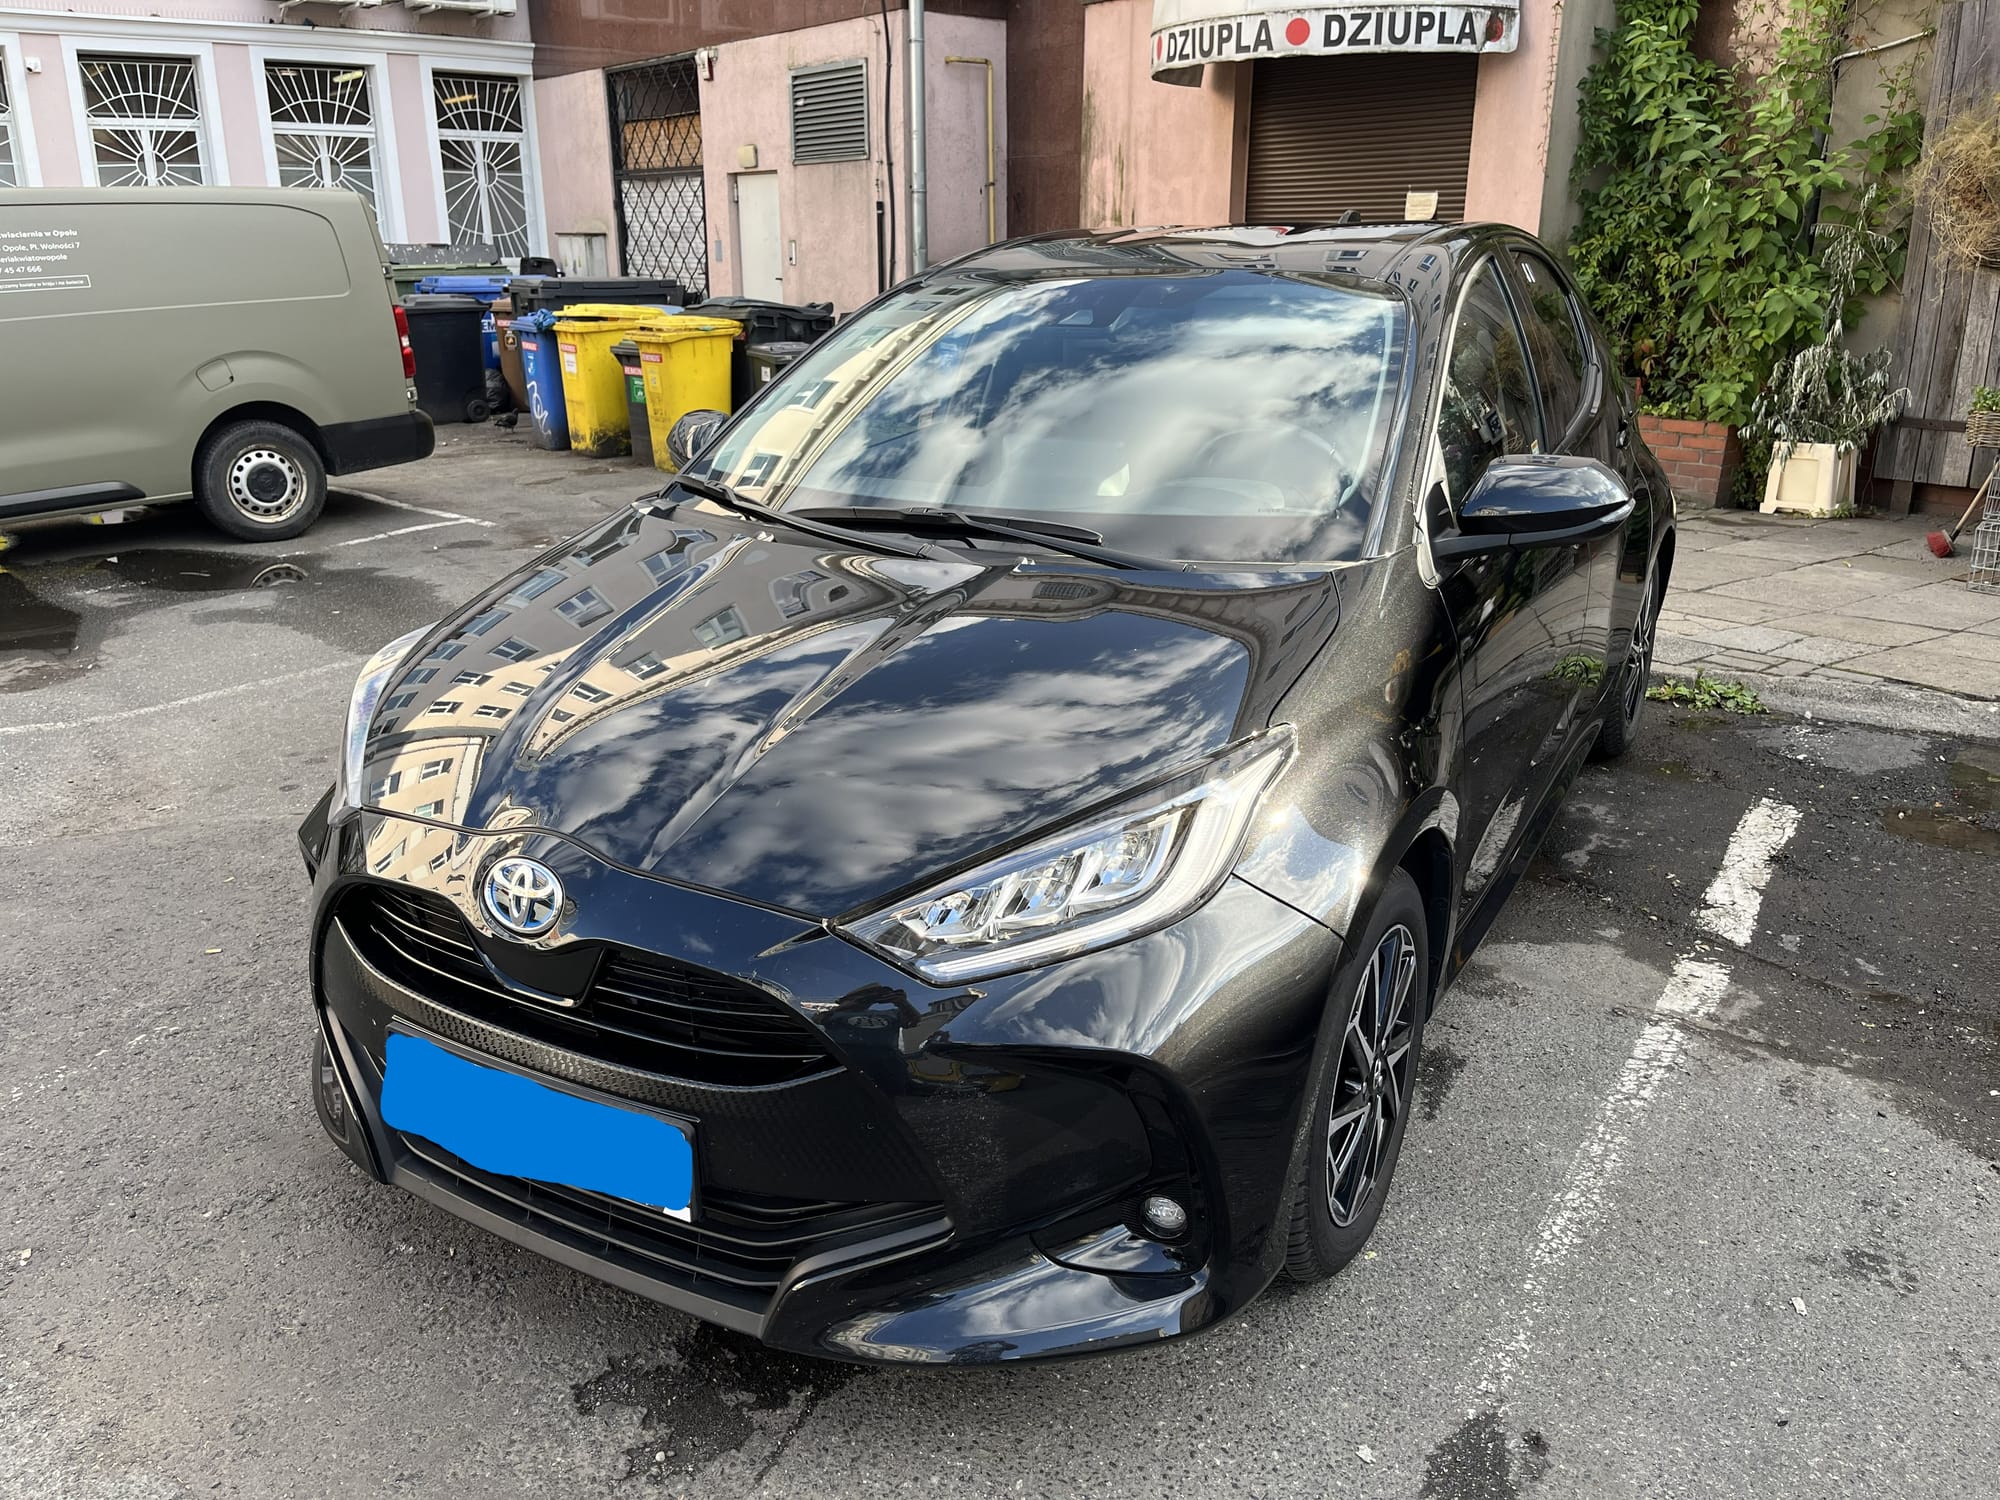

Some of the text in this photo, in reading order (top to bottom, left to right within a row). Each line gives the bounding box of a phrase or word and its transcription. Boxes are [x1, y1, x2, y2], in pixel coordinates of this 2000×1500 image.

[1166, 18, 1274, 63] DZIUPLA
[1323, 11, 1477, 48] DZIUPLA
[0, 230, 44, 239] wiaciarnia
[52, 229, 78, 238] Opolu
[75, 241, 80, 249] 7
